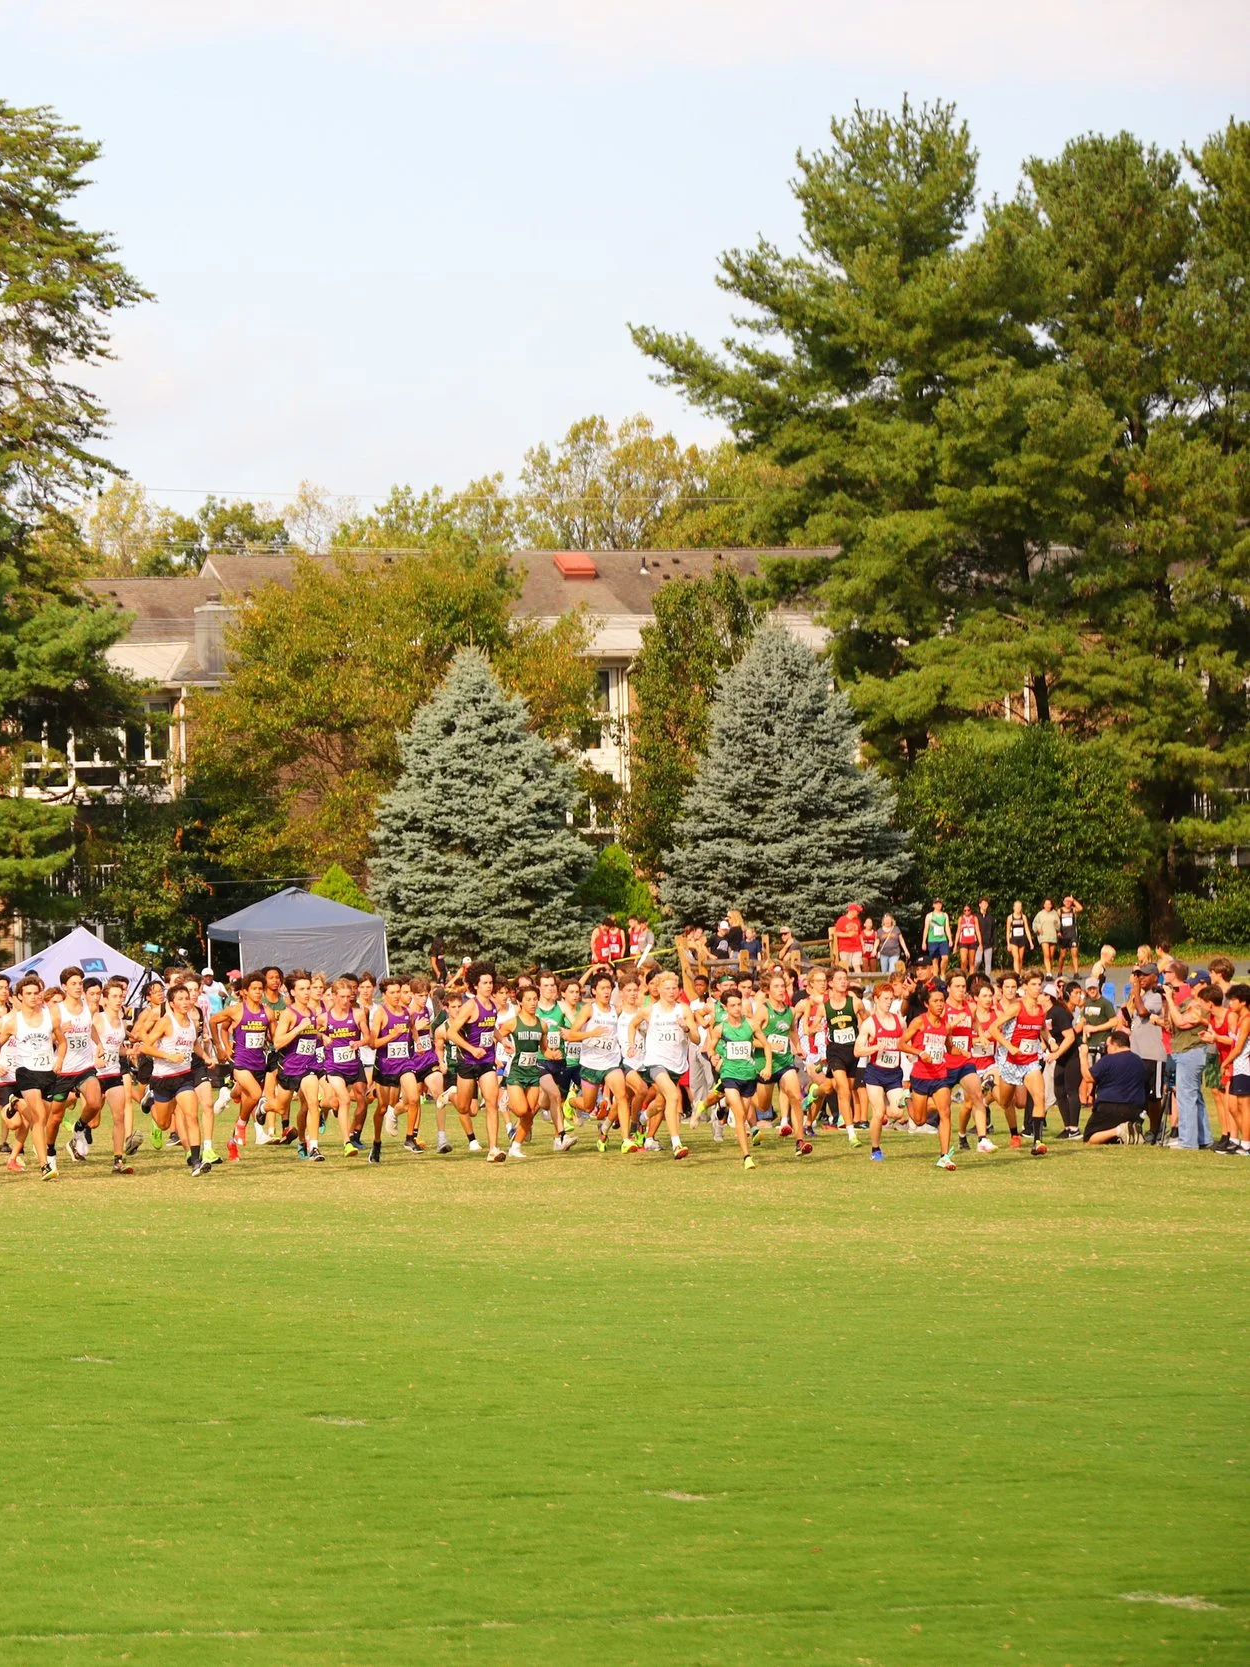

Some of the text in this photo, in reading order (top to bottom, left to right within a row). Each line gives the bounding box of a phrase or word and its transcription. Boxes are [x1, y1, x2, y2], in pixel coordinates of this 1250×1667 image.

[659, 1033, 676, 1041] 201
[837, 1033, 854, 1042] 120
[69, 1040, 87, 1049] 536
[248, 1039, 264, 1047] 372
[594, 1040, 612, 1050] 218
[390, 1048, 406, 1056] 373
[731, 1046, 748, 1055] 1595
[337, 1050, 353, 1061] 367
[881, 1055, 897, 1064] 1367
[33, 1056, 50, 1067] 721
